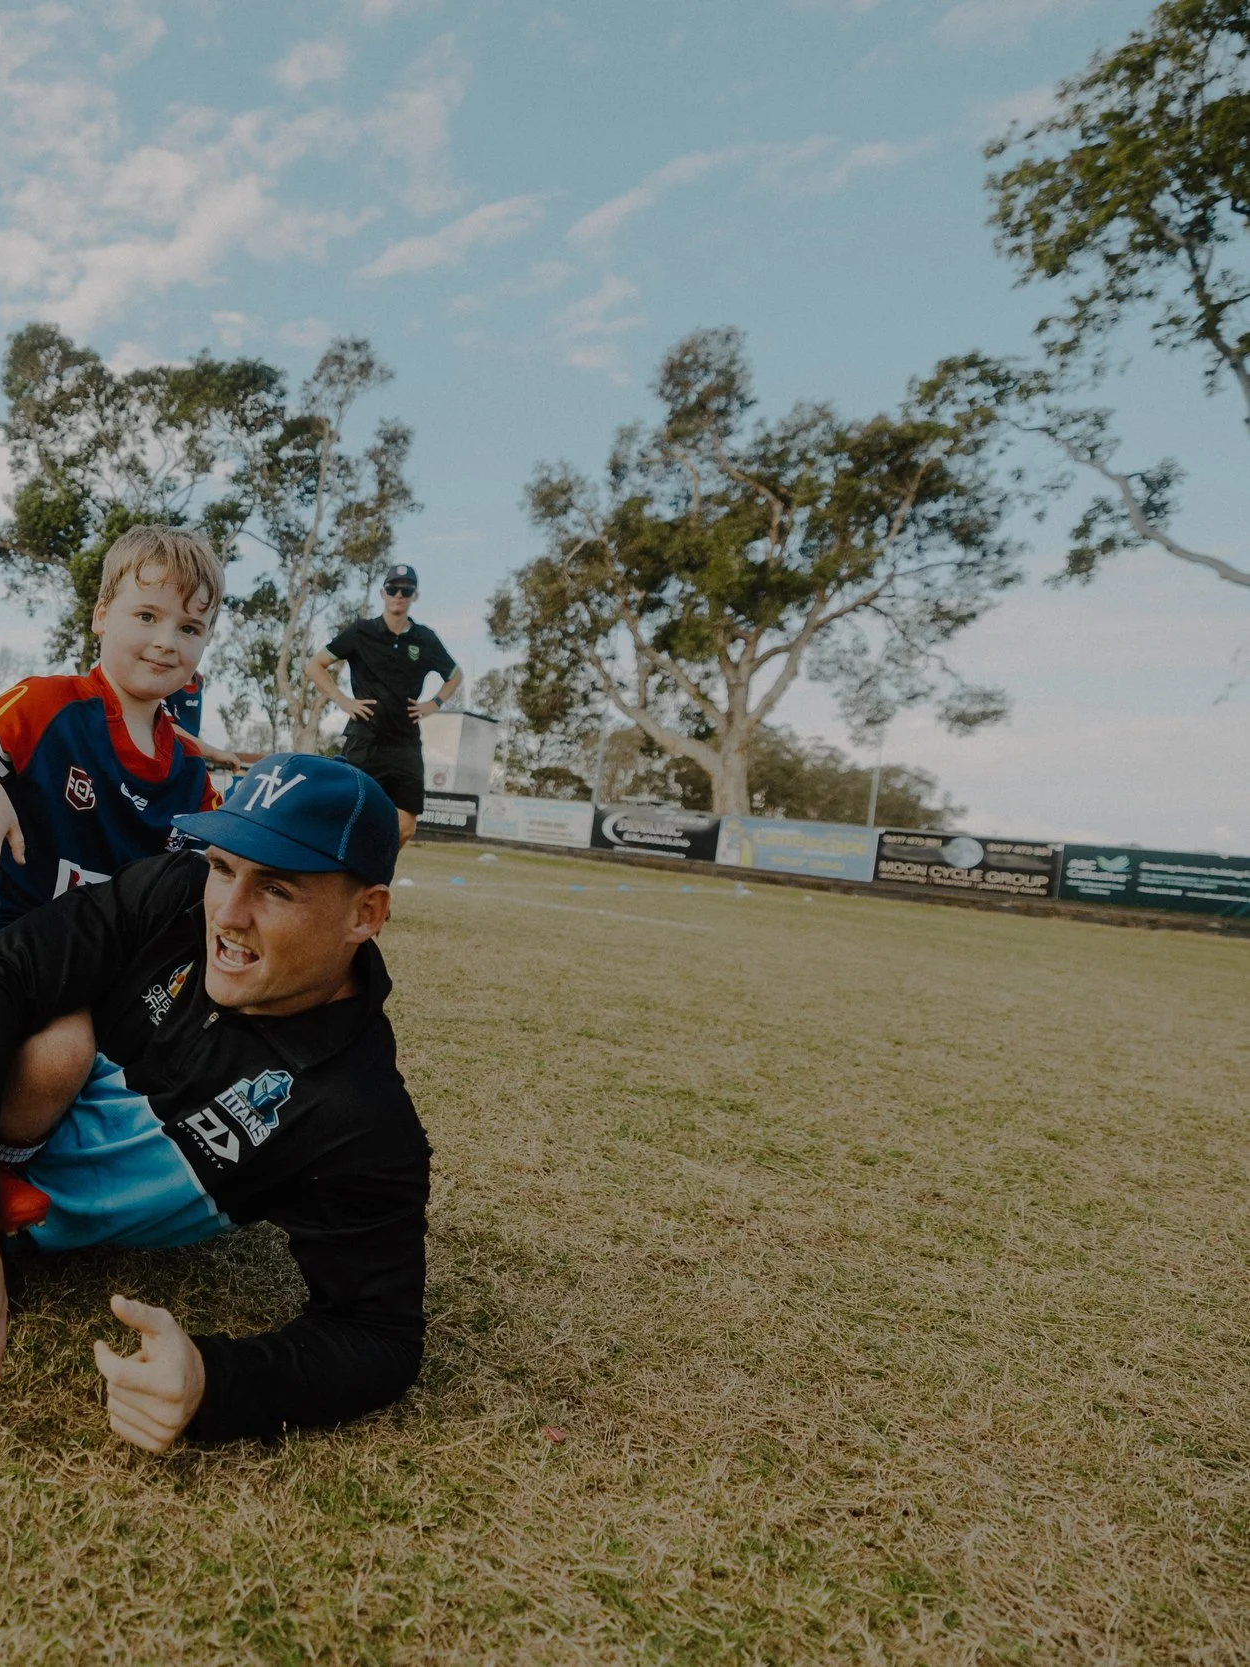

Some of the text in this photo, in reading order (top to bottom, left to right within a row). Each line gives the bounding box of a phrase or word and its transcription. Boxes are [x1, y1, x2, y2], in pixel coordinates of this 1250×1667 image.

[878, 860, 928, 876] MOON
[928, 865, 984, 882] CYCLE
[985, 870, 1049, 887] GROUP
[218, 1088, 268, 1144] TITANS
[177, 1122, 224, 1169] DYNASTY
